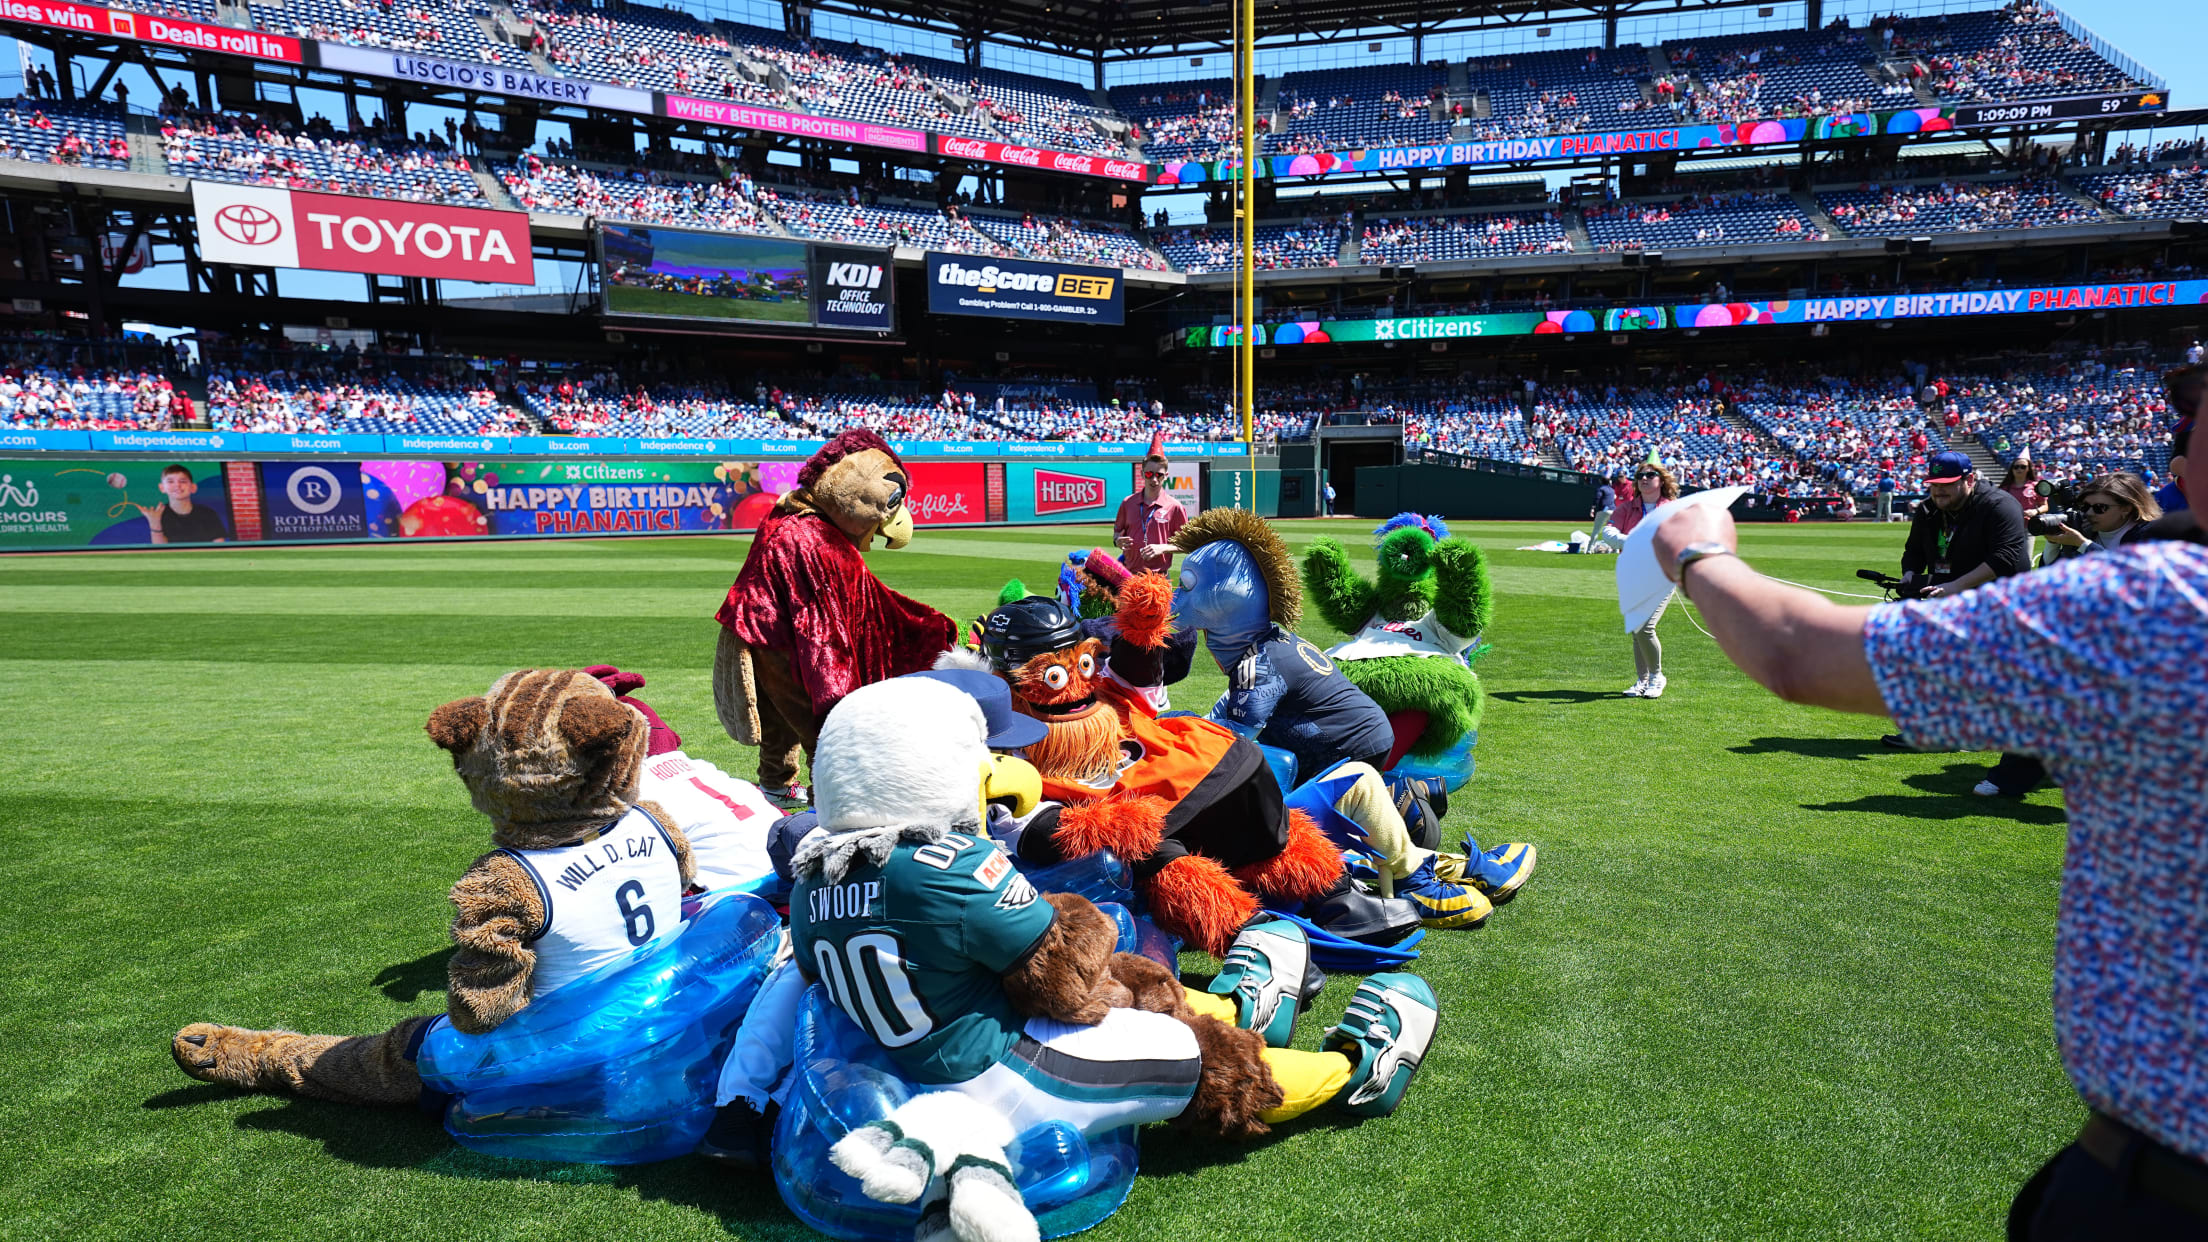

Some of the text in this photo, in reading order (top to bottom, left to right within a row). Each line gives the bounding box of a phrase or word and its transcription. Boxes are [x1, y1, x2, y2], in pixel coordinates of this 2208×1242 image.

[45, 6, 94, 29] win
[150, 20, 284, 58] Deals roll in
[395, 56, 591, 101] LISCIO'S BAKERY
[674, 100, 857, 139] WHEY BETTER PROTEIN
[1976, 107, 2028, 122] 1:09:09
[2031, 104, 2053, 118] PM
[868, 134, 916, 146] INGREDIENTS
[1378, 130, 1679, 168] HAPPY BIRTHDAY PHANATIC!
[307, 213, 517, 265] TOYOTA
[826, 262, 884, 289] KDI
[938, 262, 1113, 297] theScore BET
[839, 289, 871, 302] OFFICE
[959, 298, 990, 309] Gambling
[991, 301, 1020, 310] Problem?
[1021, 303, 1033, 311] Call
[1804, 283, 2177, 321] HAPPY BIRTHDAY PHANATIC!
[826, 299, 885, 315] TECHNOLOGY
[1397, 318, 1483, 338] Citizens
[113, 435, 207, 447] Independence
[291, 437, 341, 449] ibx.com
[402, 438, 479, 450] Independence
[548, 440, 590, 450] ibx.com
[640, 440, 704, 452] Independence
[762, 443, 797, 452] ibx.com
[943, 444, 973, 453] ibx.com
[1008, 444, 1057, 454] Independence
[1098, 445, 1124, 453] ibx.com
[1217, 446, 1242, 454] ibx.com
[583, 464, 645, 480] Citizens
[303, 481, 327, 498] R
[486, 485, 717, 510] HAPPY BIRTHDAY
[1040, 480, 1098, 503] HERR'S
[274, 514, 361, 527] ROTHMAN
[274, 524, 362, 534] ORTHOPAEDICS
[535, 508, 681, 533] PHANATIC!
[688, 776, 756, 821] 1
[556, 836, 656, 892] WILL D. CAT
[809, 881, 880, 924] SWOOP
[615, 878, 656, 947] 6
[813, 930, 938, 1050] 00
